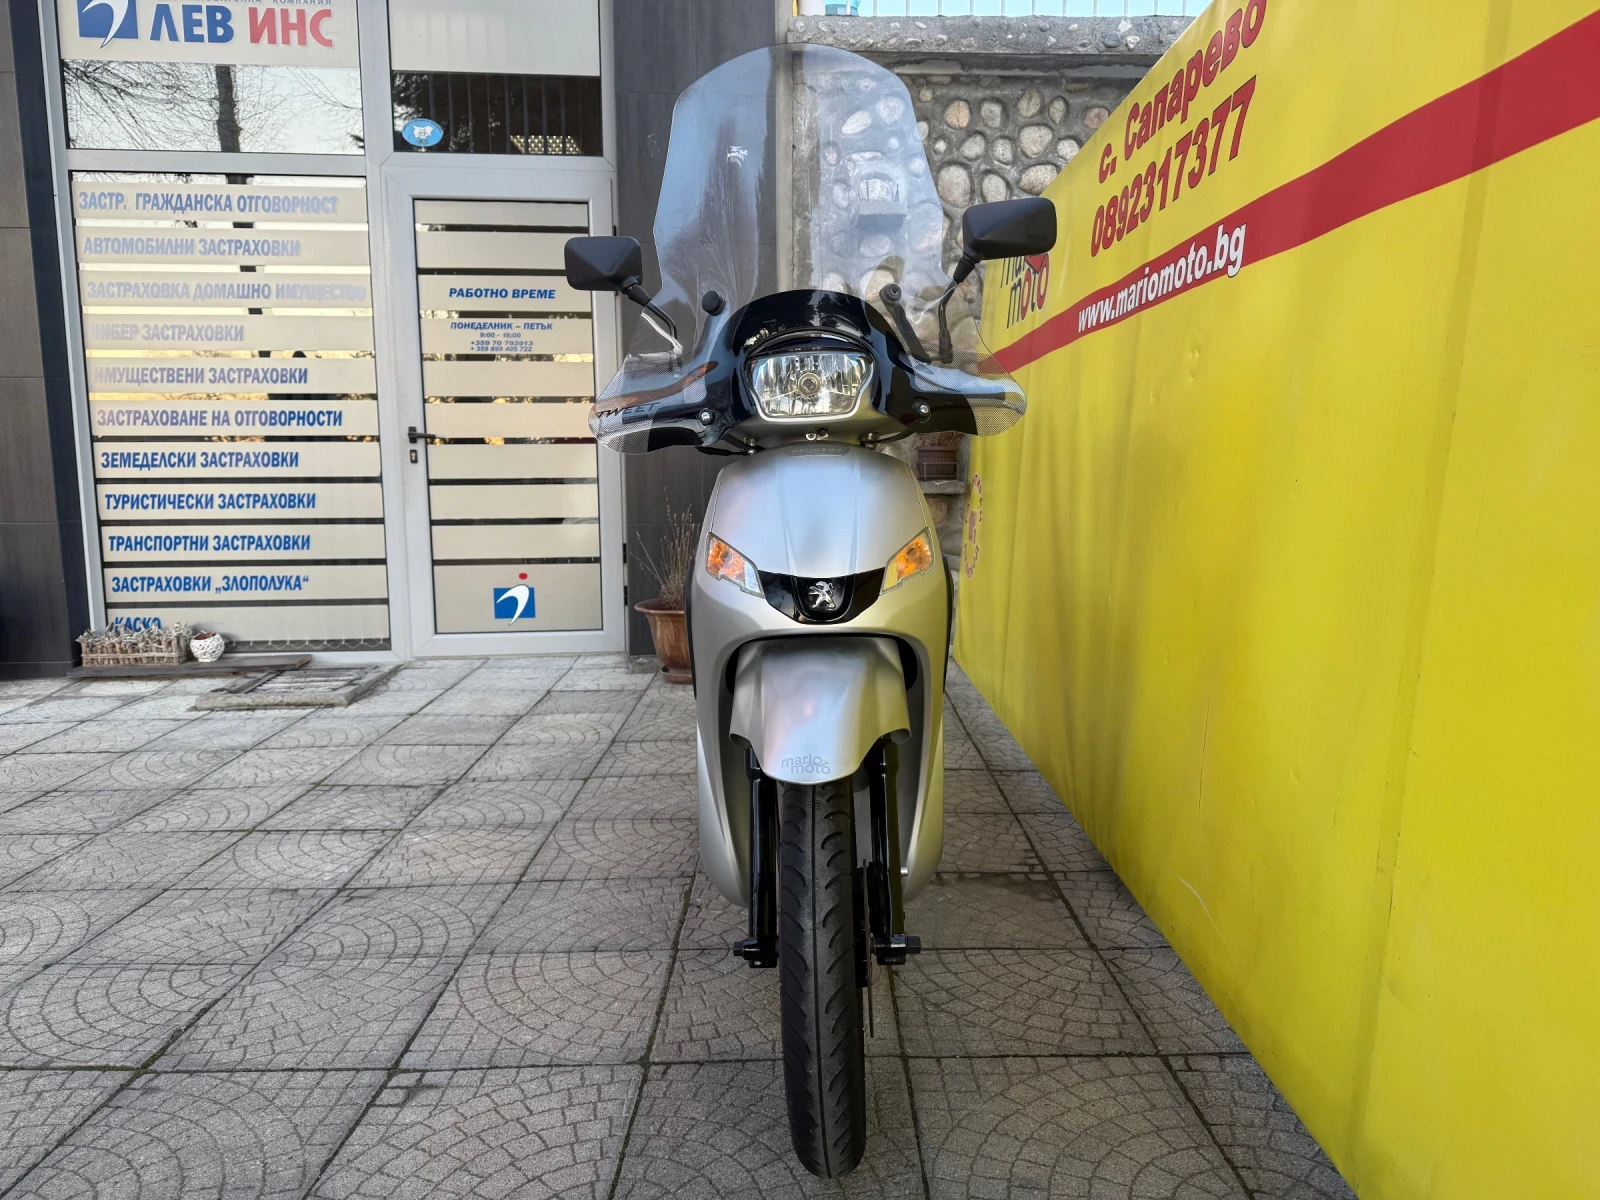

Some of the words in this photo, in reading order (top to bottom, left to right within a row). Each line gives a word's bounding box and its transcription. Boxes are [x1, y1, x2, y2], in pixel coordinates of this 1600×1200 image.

[150, 4, 234, 43] ЛЕВ
[248, 7, 332, 47] ИНС
[1124, 0, 1267, 160] Сапарево
[1090, 74, 1257, 257] 0892317377
[78, 191, 127, 210] ЗАСТР.
[135, 193, 232, 214] ГРАЖДАНСКА
[236, 195, 338, 213] ОТГОВОРНОСТ
[83, 237, 194, 255] АВТОМОБИЛНИ
[198, 238, 300, 257] ЗАСТРАХОВКИ
[1078, 222, 1247, 332] www.mariomoto.bg
[87, 281, 189, 299] ЗАСТРАХОВКА
[193, 283, 271, 302] ДОМАШНО
[449, 288, 508, 298] РАБОТНО
[512, 289, 556, 299] ВРЕМЕ
[1007, 252, 1049, 329] moto
[142, 324, 244, 342] ЗАСТРАХОВКИ
[450, 322, 513, 330] ПОНЕДЕЛНИК
[94, 367, 205, 386] ИМУЩЕСТВЕНИ
[208, 367, 308, 384] ЗАСТРАХОВКИ
[97, 410, 207, 427] ЗАСТРАХОВАНЕ
[211, 410, 230, 426] НА
[234, 410, 342, 427] ОТГОВОРНОСТИ
[596, 402, 661, 418] TWEET
[101, 452, 196, 470] ЗЕМЕДЕЛСКИ
[200, 451, 299, 468] ЗАСТРАХОВКИ
[105, 493, 214, 510] ТУРИСТИЧЕСКИ
[218, 493, 316, 509] ЗАСТРАХОВКИ
[108, 535, 208, 551] ТРАНСПОРТНИ
[213, 534, 311, 551] ЗАСТРАХОВКИ
[111, 576, 211, 592] ЗАСТРАХОВКИ
